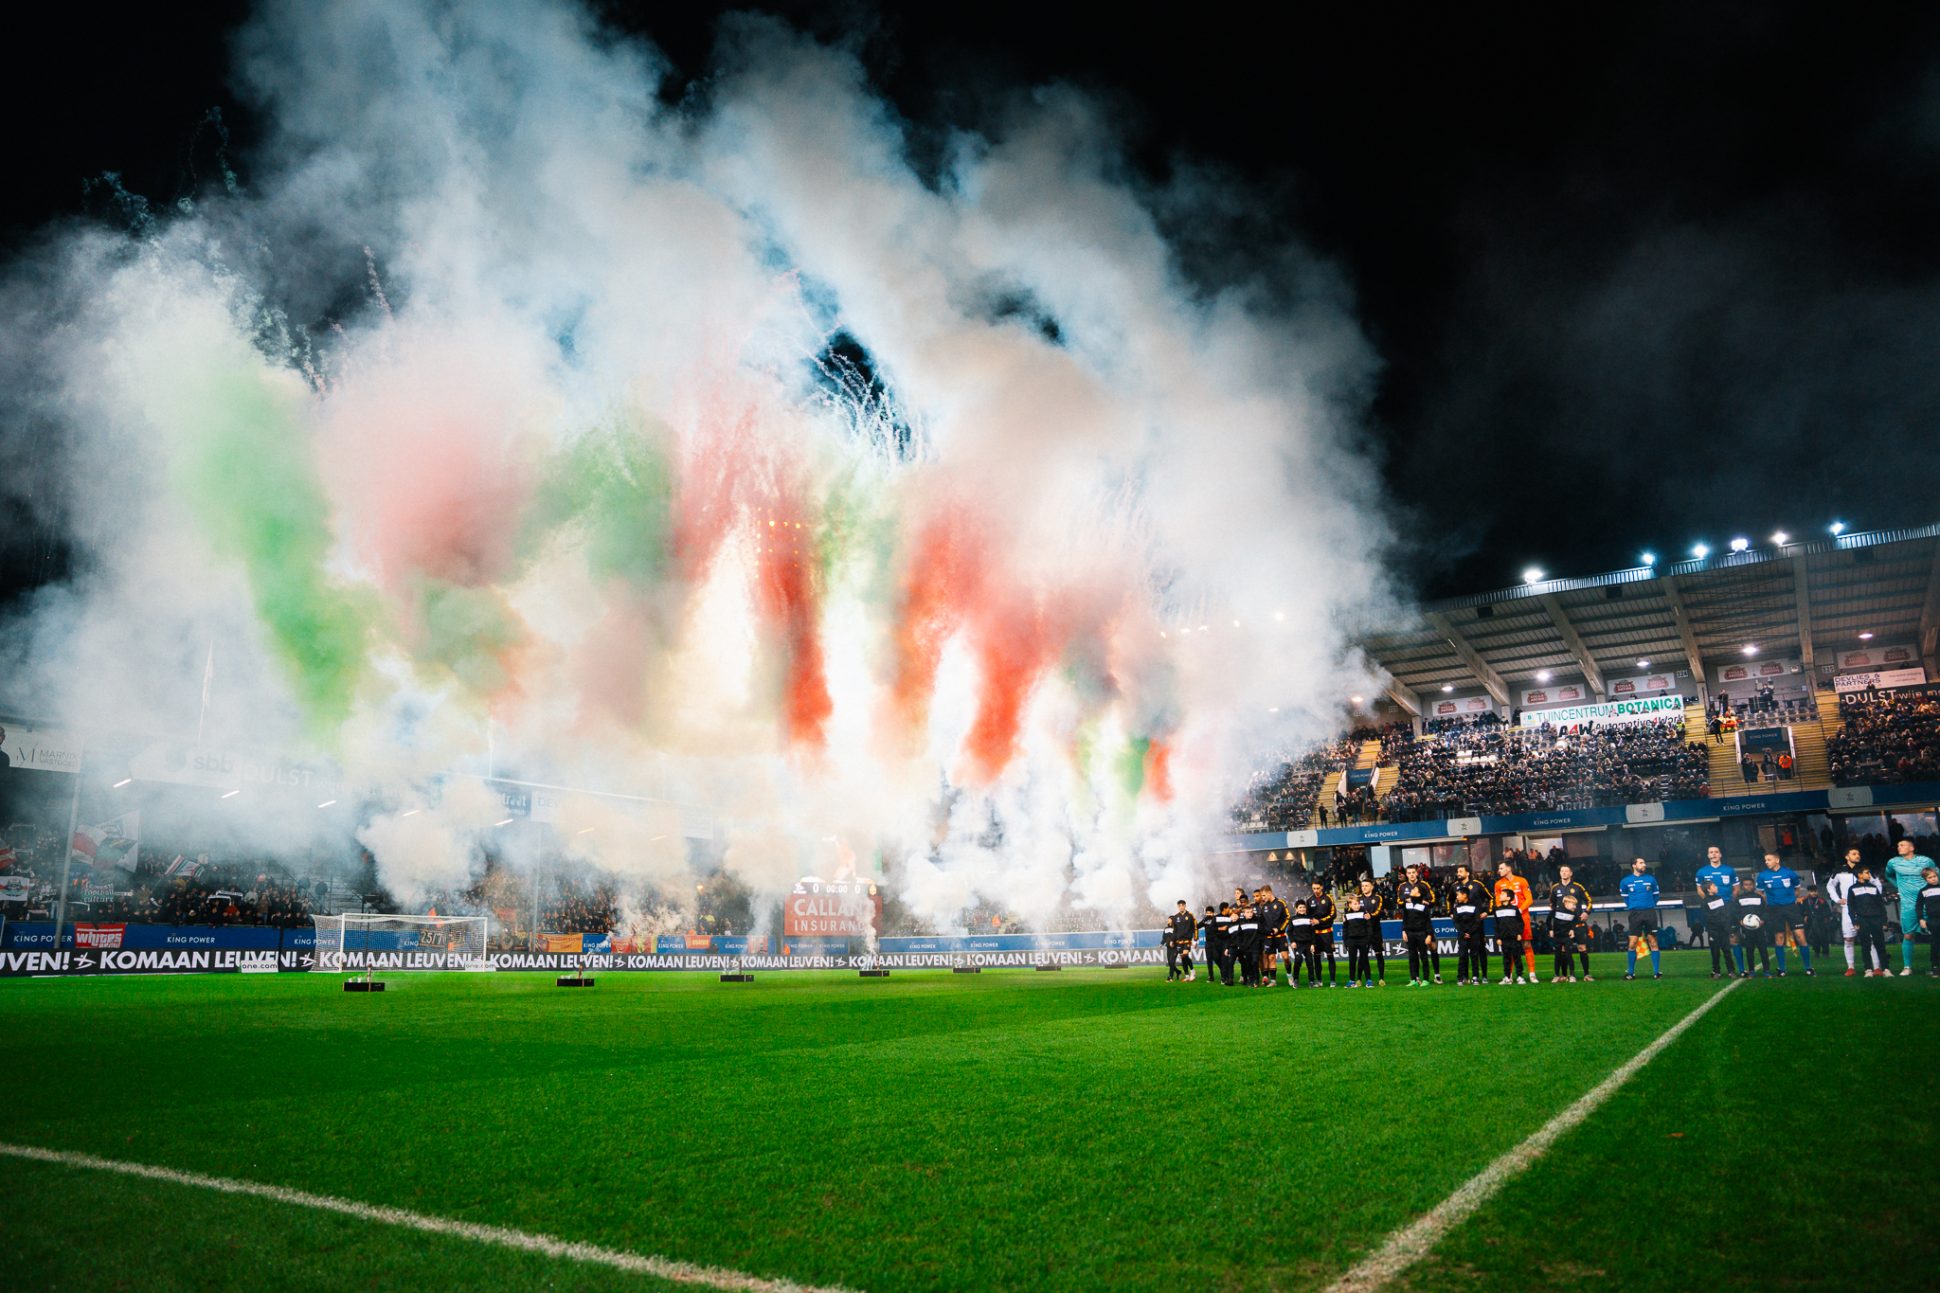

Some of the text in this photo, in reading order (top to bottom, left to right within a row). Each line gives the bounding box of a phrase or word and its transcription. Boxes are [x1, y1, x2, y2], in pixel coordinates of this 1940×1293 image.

[1835, 673, 1870, 682] DEVLIES
[1537, 698, 1682, 721] TUINCENTRUM BOTANICA
[14, 935, 72, 943] KING POER
[100, 951, 210, 969] KOMAAN
[215, 951, 297, 968] LEUVEN!
[320, 951, 402, 968] KOMAAN
[407, 952, 471, 968] LEUVEN!
[490, 954, 558, 968] KOMAAN
[560, 954, 613, 968] LEUVEN!
[627, 955, 684, 969] KOMAAN
[686, 956, 729, 968] LEUVEN!
[741, 956, 787, 968] KOMAAN
[790, 956, 834, 968] LEUVEN!
[849, 955, 903, 967] KOMAAN
[906, 954, 952, 966] LEUVEN!
[967, 953, 1026, 966] KOMAAN
[1029, 951, 1082, 965] LEUVEN!
[1098, 949, 1164, 963] KOMAAN
